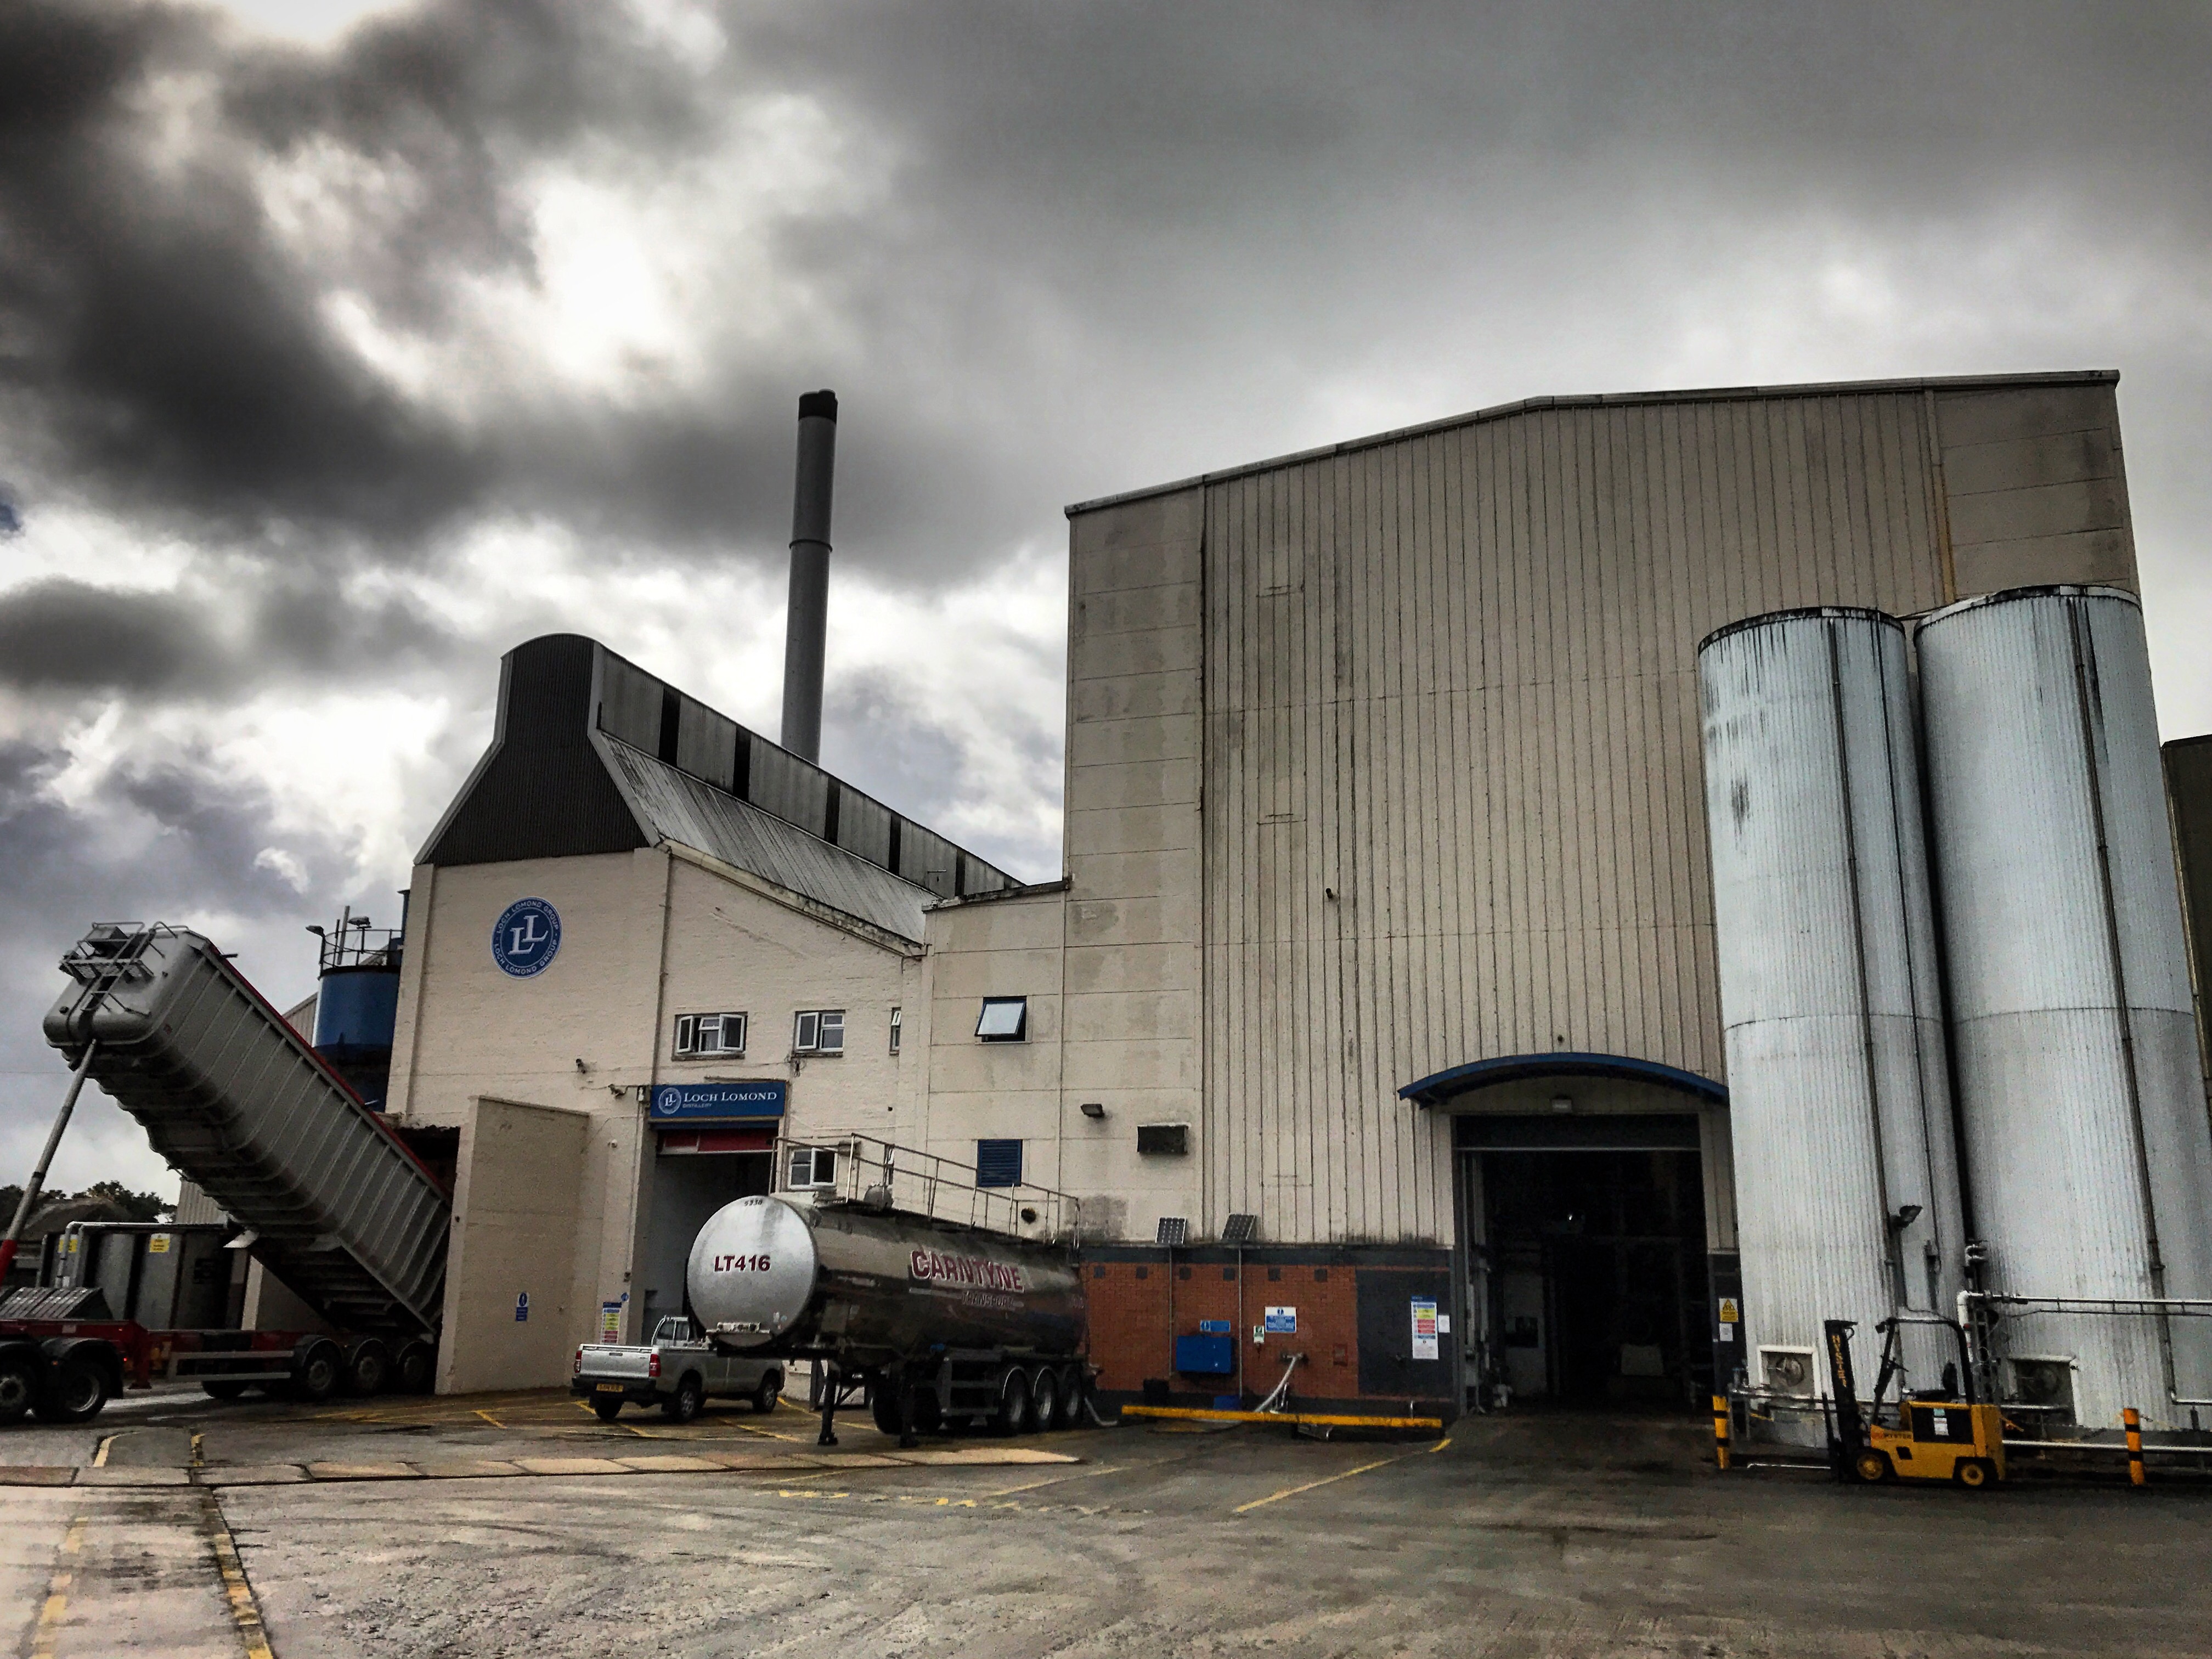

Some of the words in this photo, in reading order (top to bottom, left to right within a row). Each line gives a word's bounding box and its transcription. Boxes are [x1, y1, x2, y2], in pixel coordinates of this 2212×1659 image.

[496, 912, 510, 934] LOCH
[512, 900, 542, 912] LOMOND
[544, 906, 559, 930] GROUP
[494, 944, 505, 964] LOCH
[505, 964, 537, 974] LOMOND
[539, 939, 557, 966] GROUP
[684, 1092, 718, 1102] LOCH
[721, 1092, 777, 1101] LOMOND
[714, 1255, 771, 1272] LT416
[911, 1250, 1024, 1294] CARNTYNE
